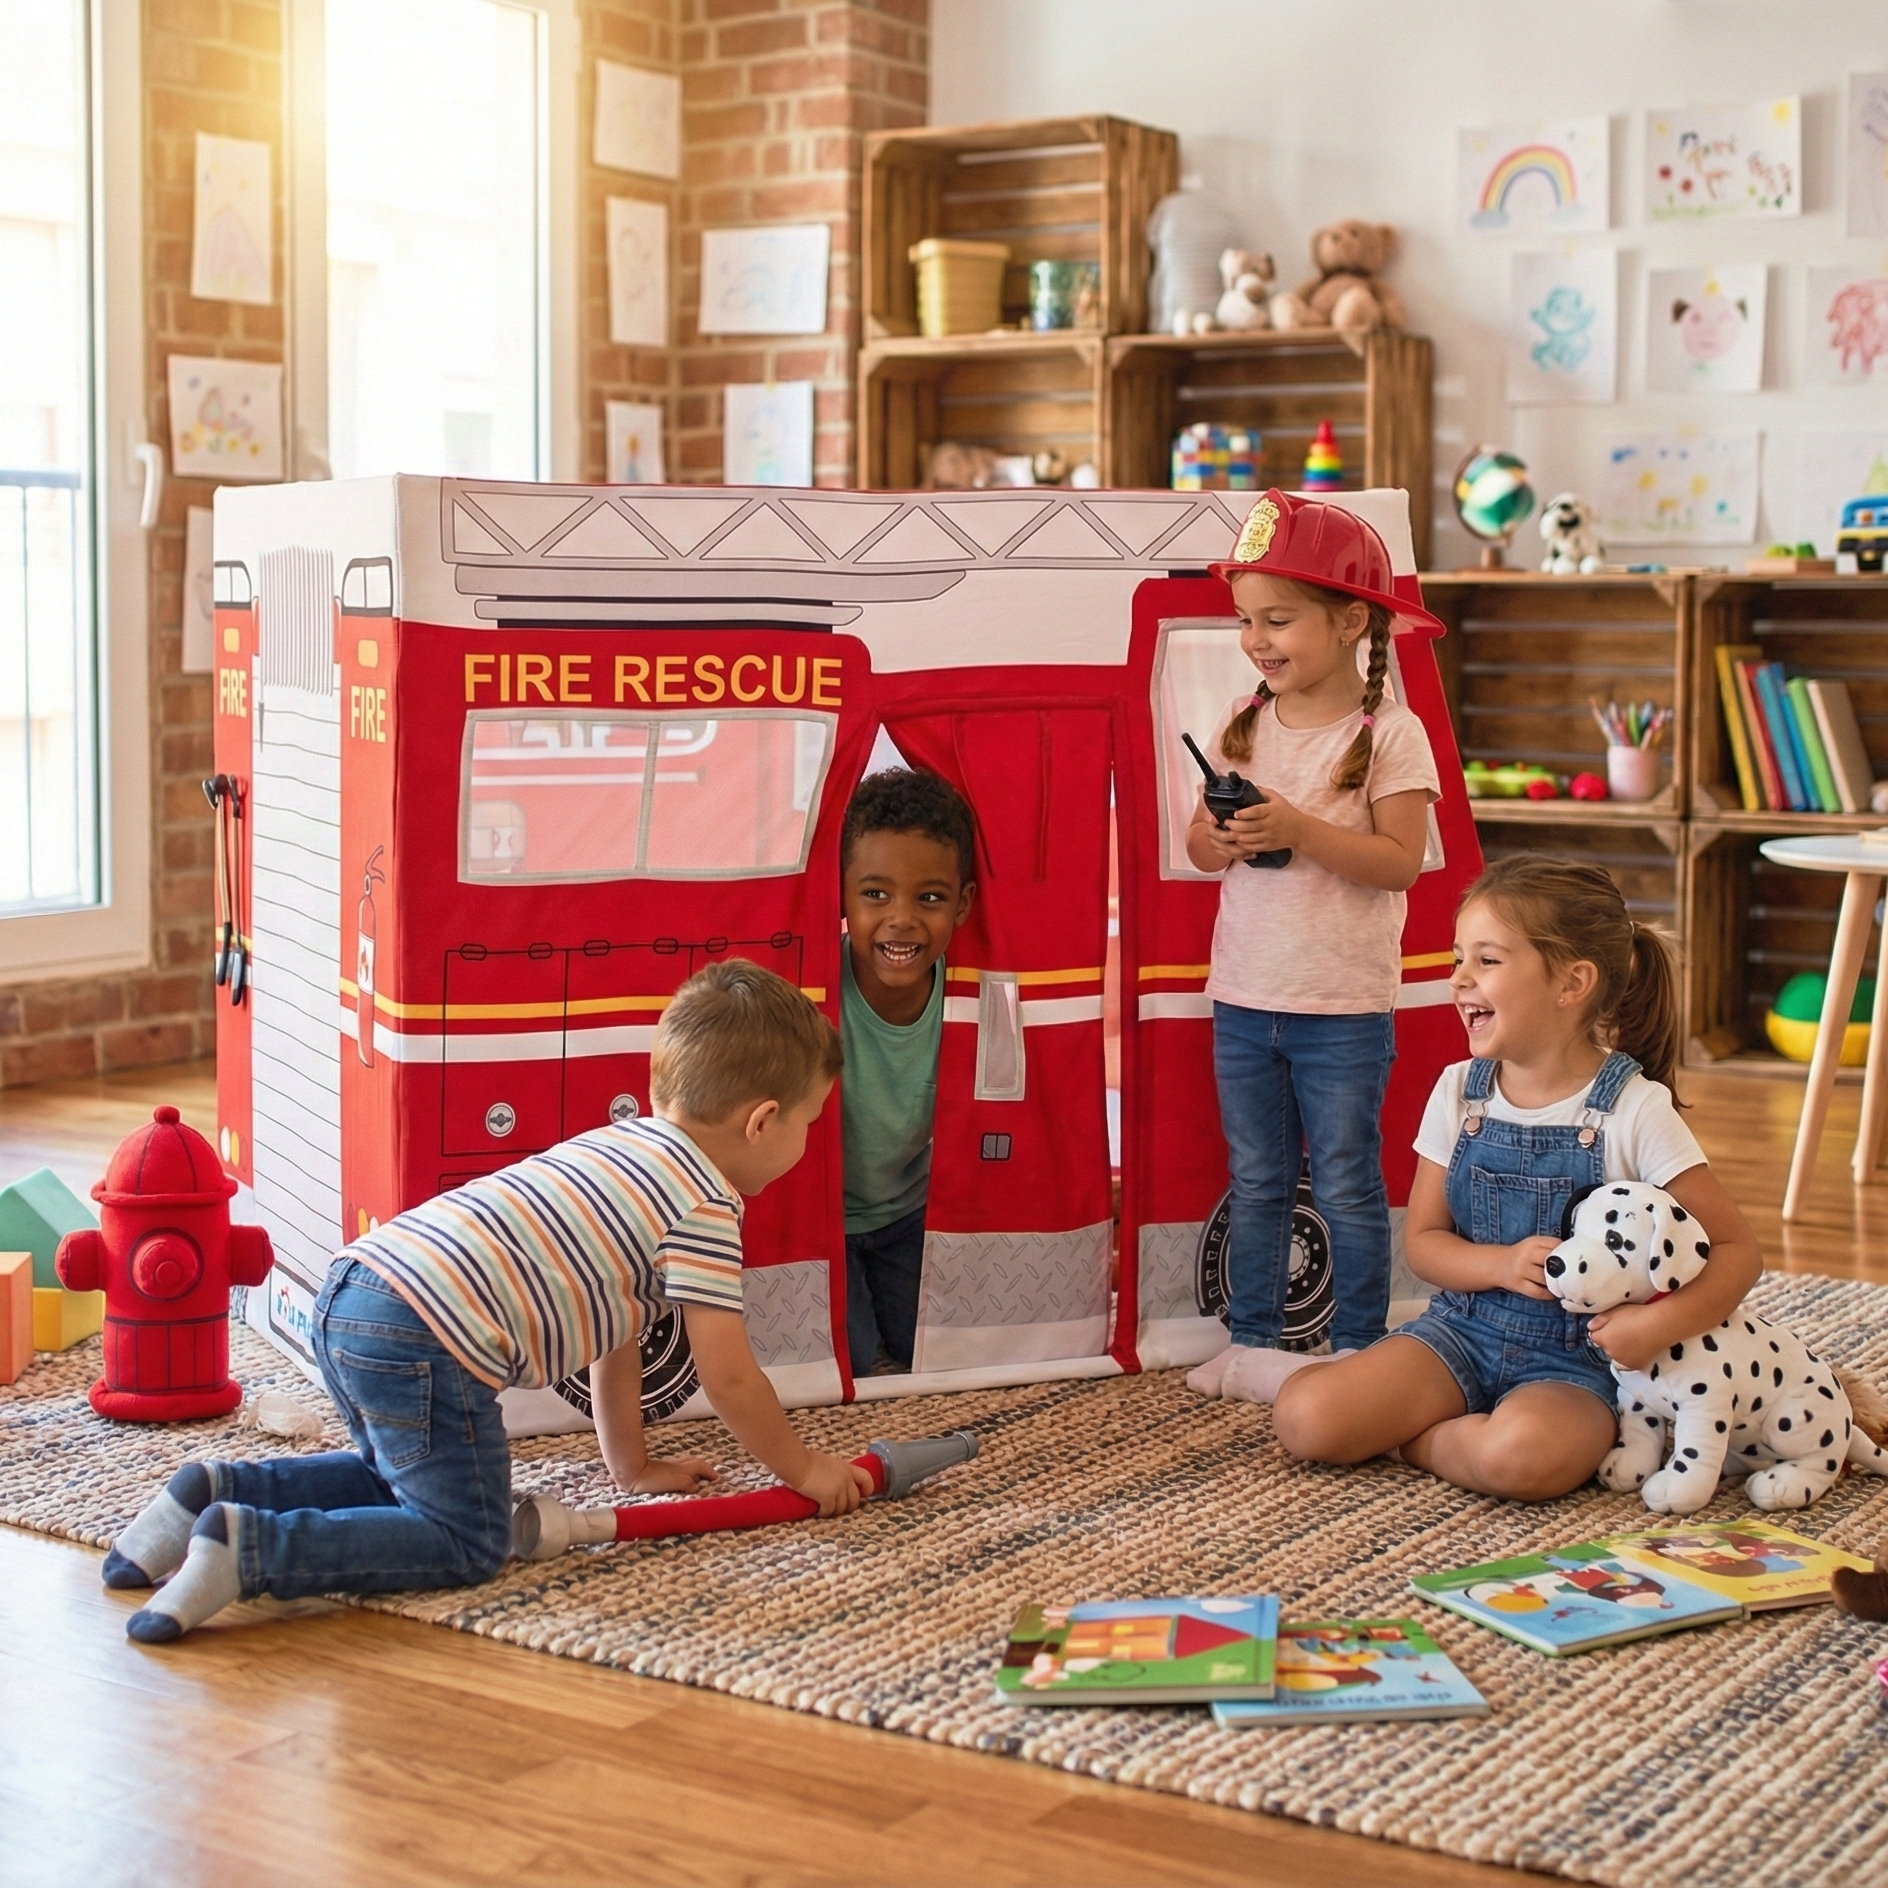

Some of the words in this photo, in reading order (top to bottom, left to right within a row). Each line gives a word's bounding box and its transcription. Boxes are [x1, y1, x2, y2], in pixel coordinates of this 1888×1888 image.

[219, 667, 247, 718] FIRE
[464, 653, 592, 703] FIRE
[614, 653, 843, 706] RESCUE
[350, 685, 387, 744] FIRE
